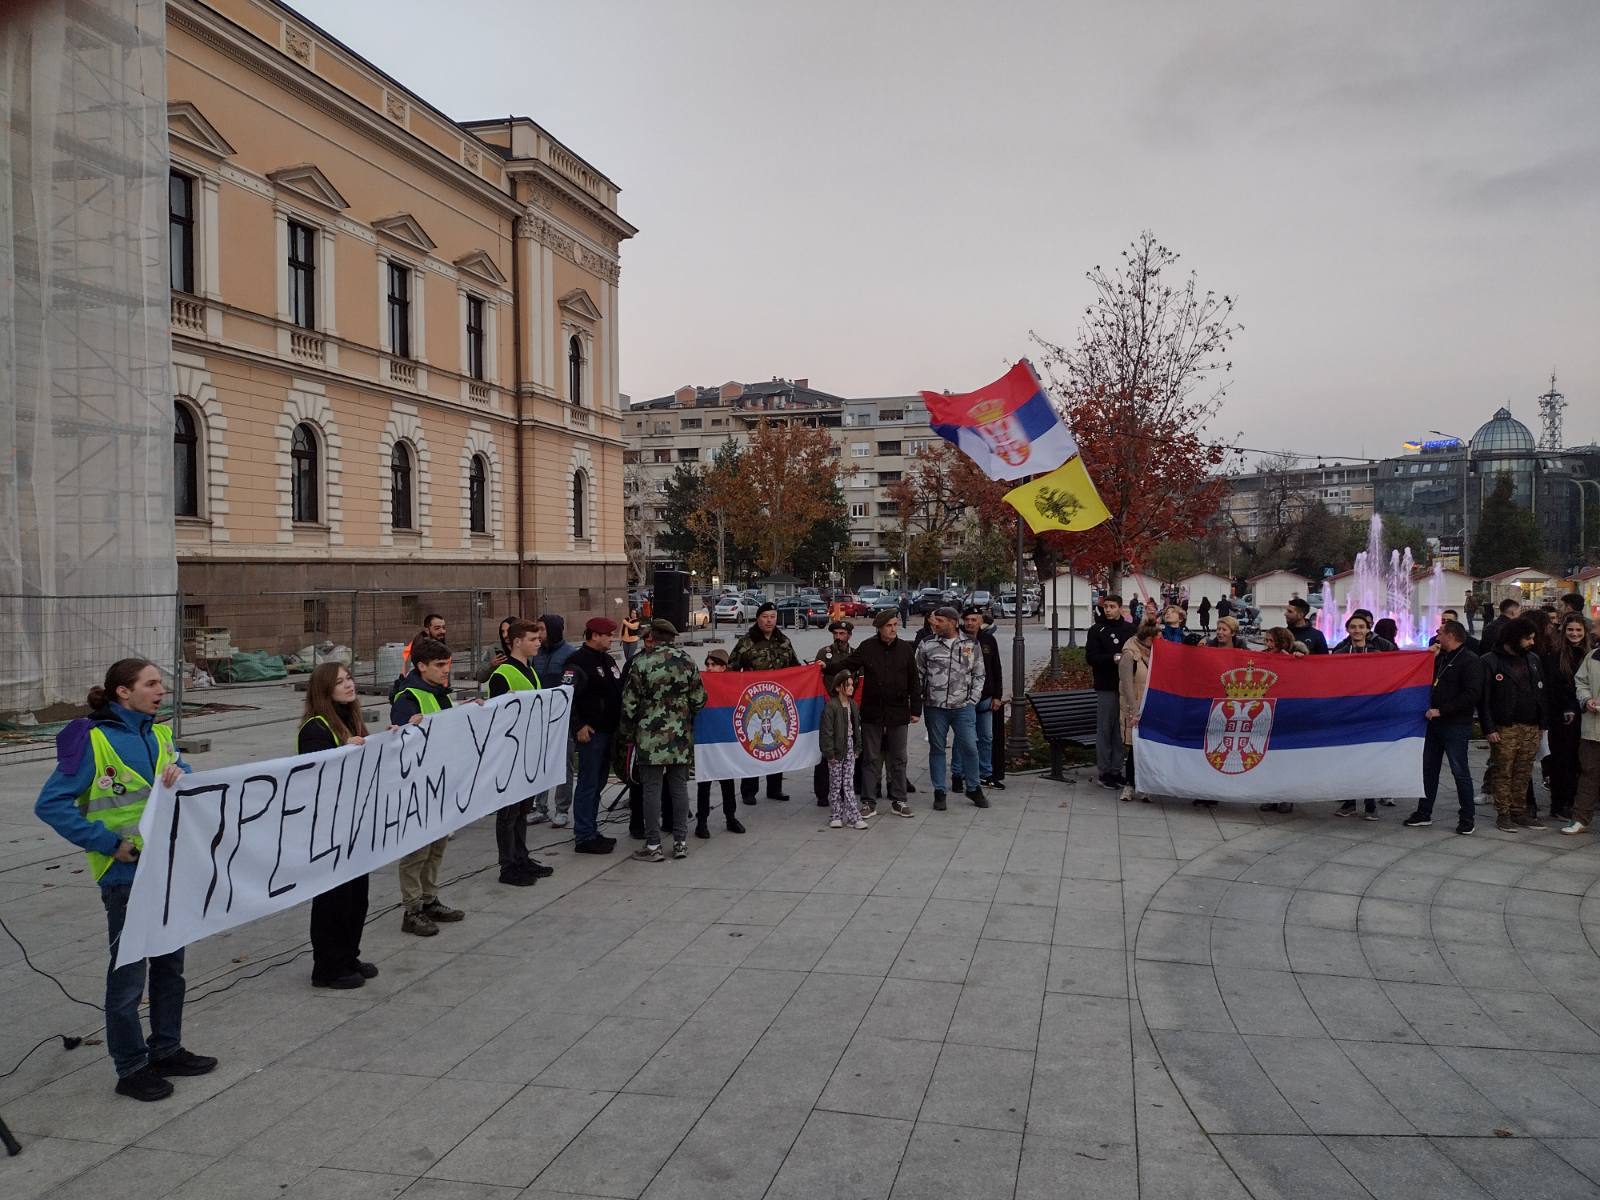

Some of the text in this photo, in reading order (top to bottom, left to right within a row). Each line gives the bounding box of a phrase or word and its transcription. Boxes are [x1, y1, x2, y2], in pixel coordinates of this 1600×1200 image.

[735, 683, 797, 742] САВЕЗ РАТНИХ ВЕТЕРАНА
[752, 744, 787, 760] СРБИЈЕ
[163, 689, 568, 926] ПРЕЦИ СУ НАМ УЗОР
